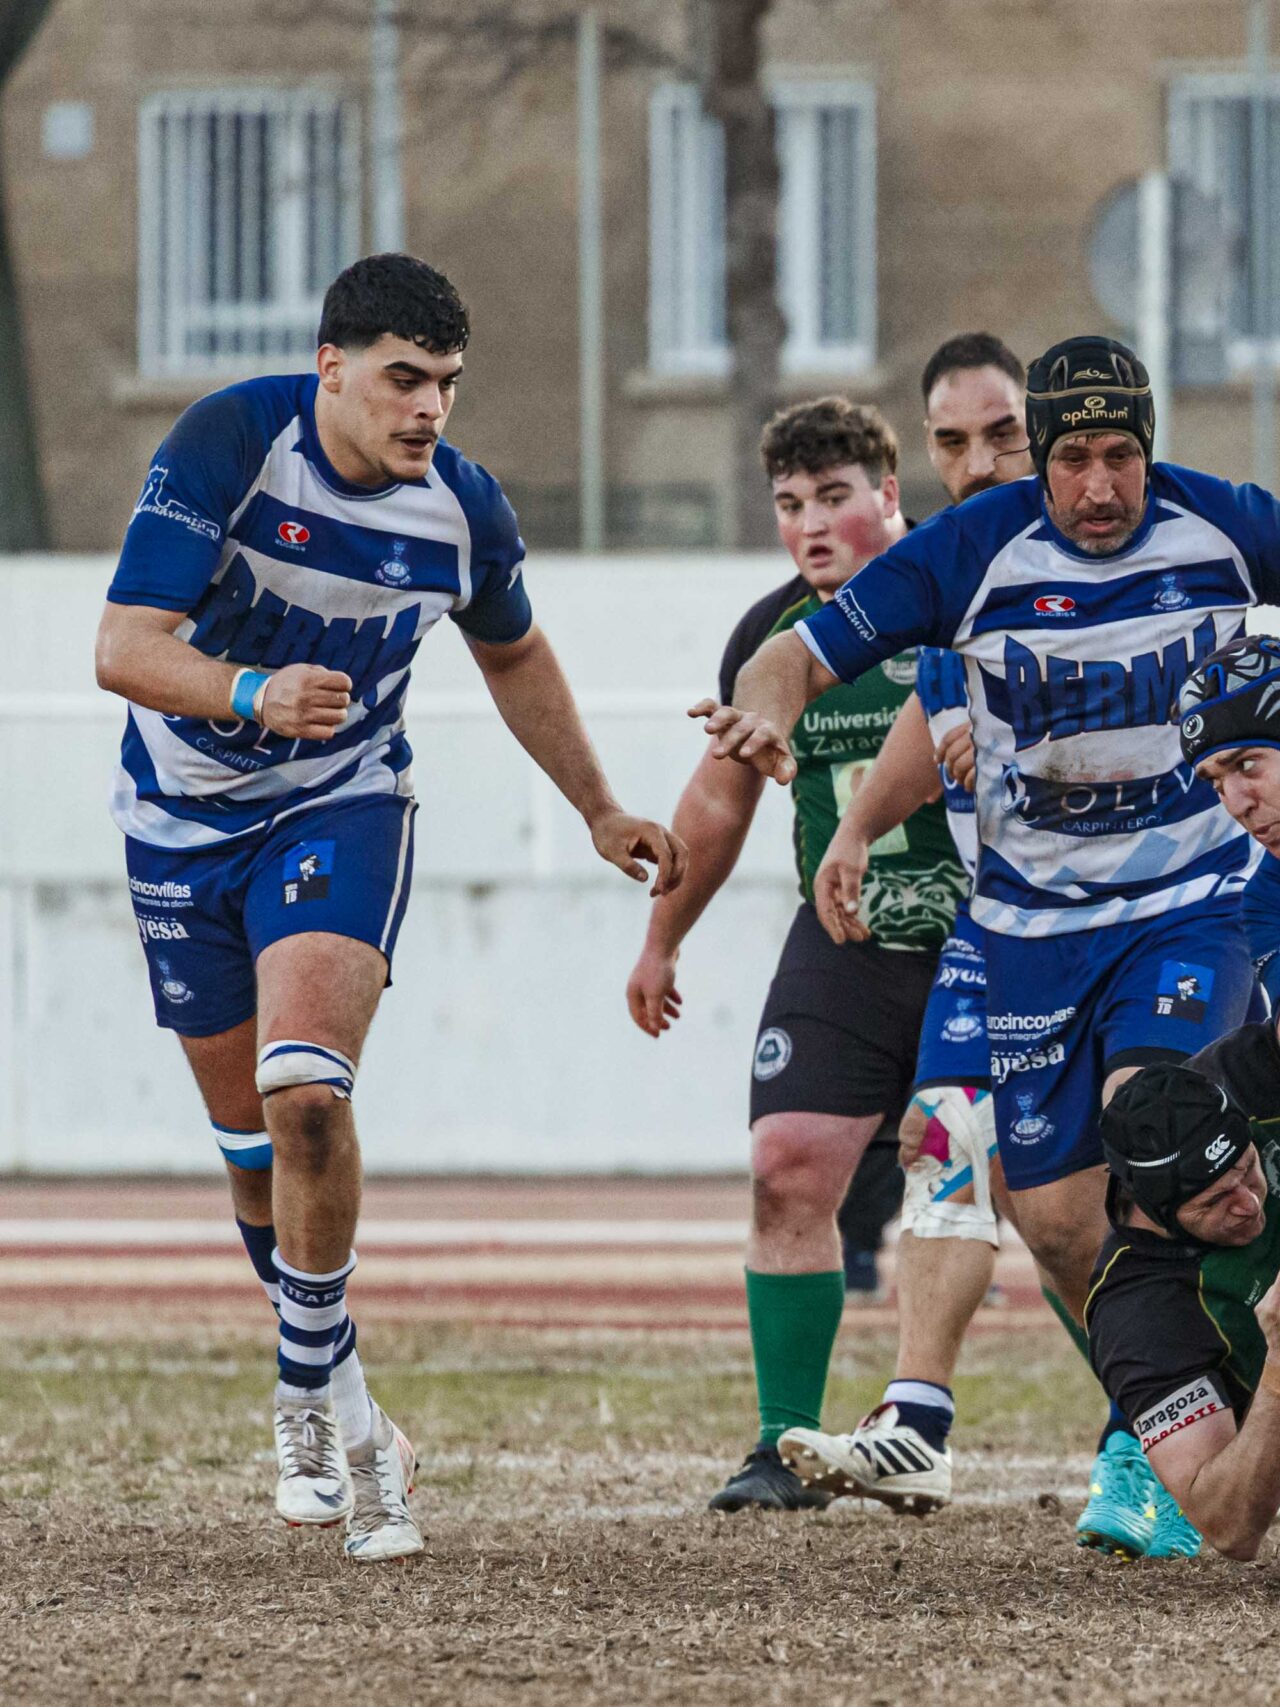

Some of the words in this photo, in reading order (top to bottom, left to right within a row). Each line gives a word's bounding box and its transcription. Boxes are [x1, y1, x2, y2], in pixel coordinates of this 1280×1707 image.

[1062, 408, 1128, 426] optimum
[804, 706, 902, 732] Universid
[808, 735, 884, 755] Zara
[130, 877, 191, 898] cincovillas
[138, 918, 190, 943] yesa
[991, 1043, 1065, 1084] ayesa
[1136, 1386, 1208, 1435] Zaragoza
